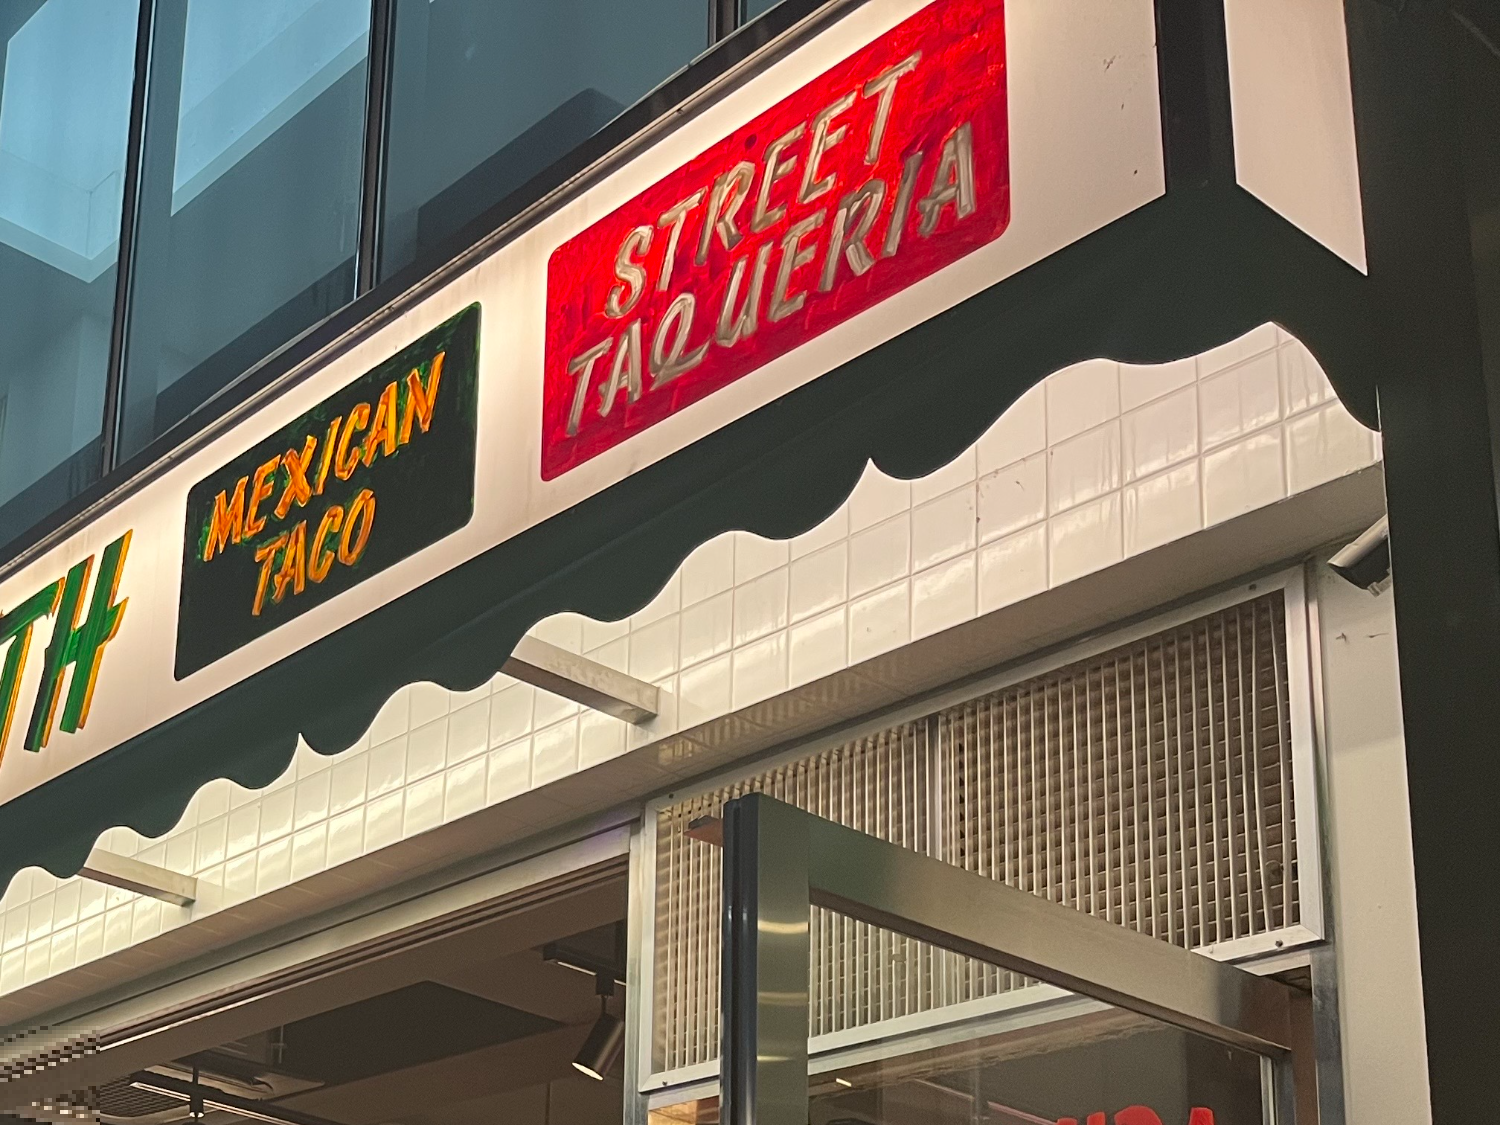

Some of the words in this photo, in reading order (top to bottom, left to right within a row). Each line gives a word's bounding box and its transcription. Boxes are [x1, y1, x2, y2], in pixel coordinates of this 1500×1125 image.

[564, 121, 974, 438] TAQUERIA
[606, 51, 922, 320] STREET
[204, 351, 445, 562] MEXICAN
[251, 489, 377, 617] TACO
